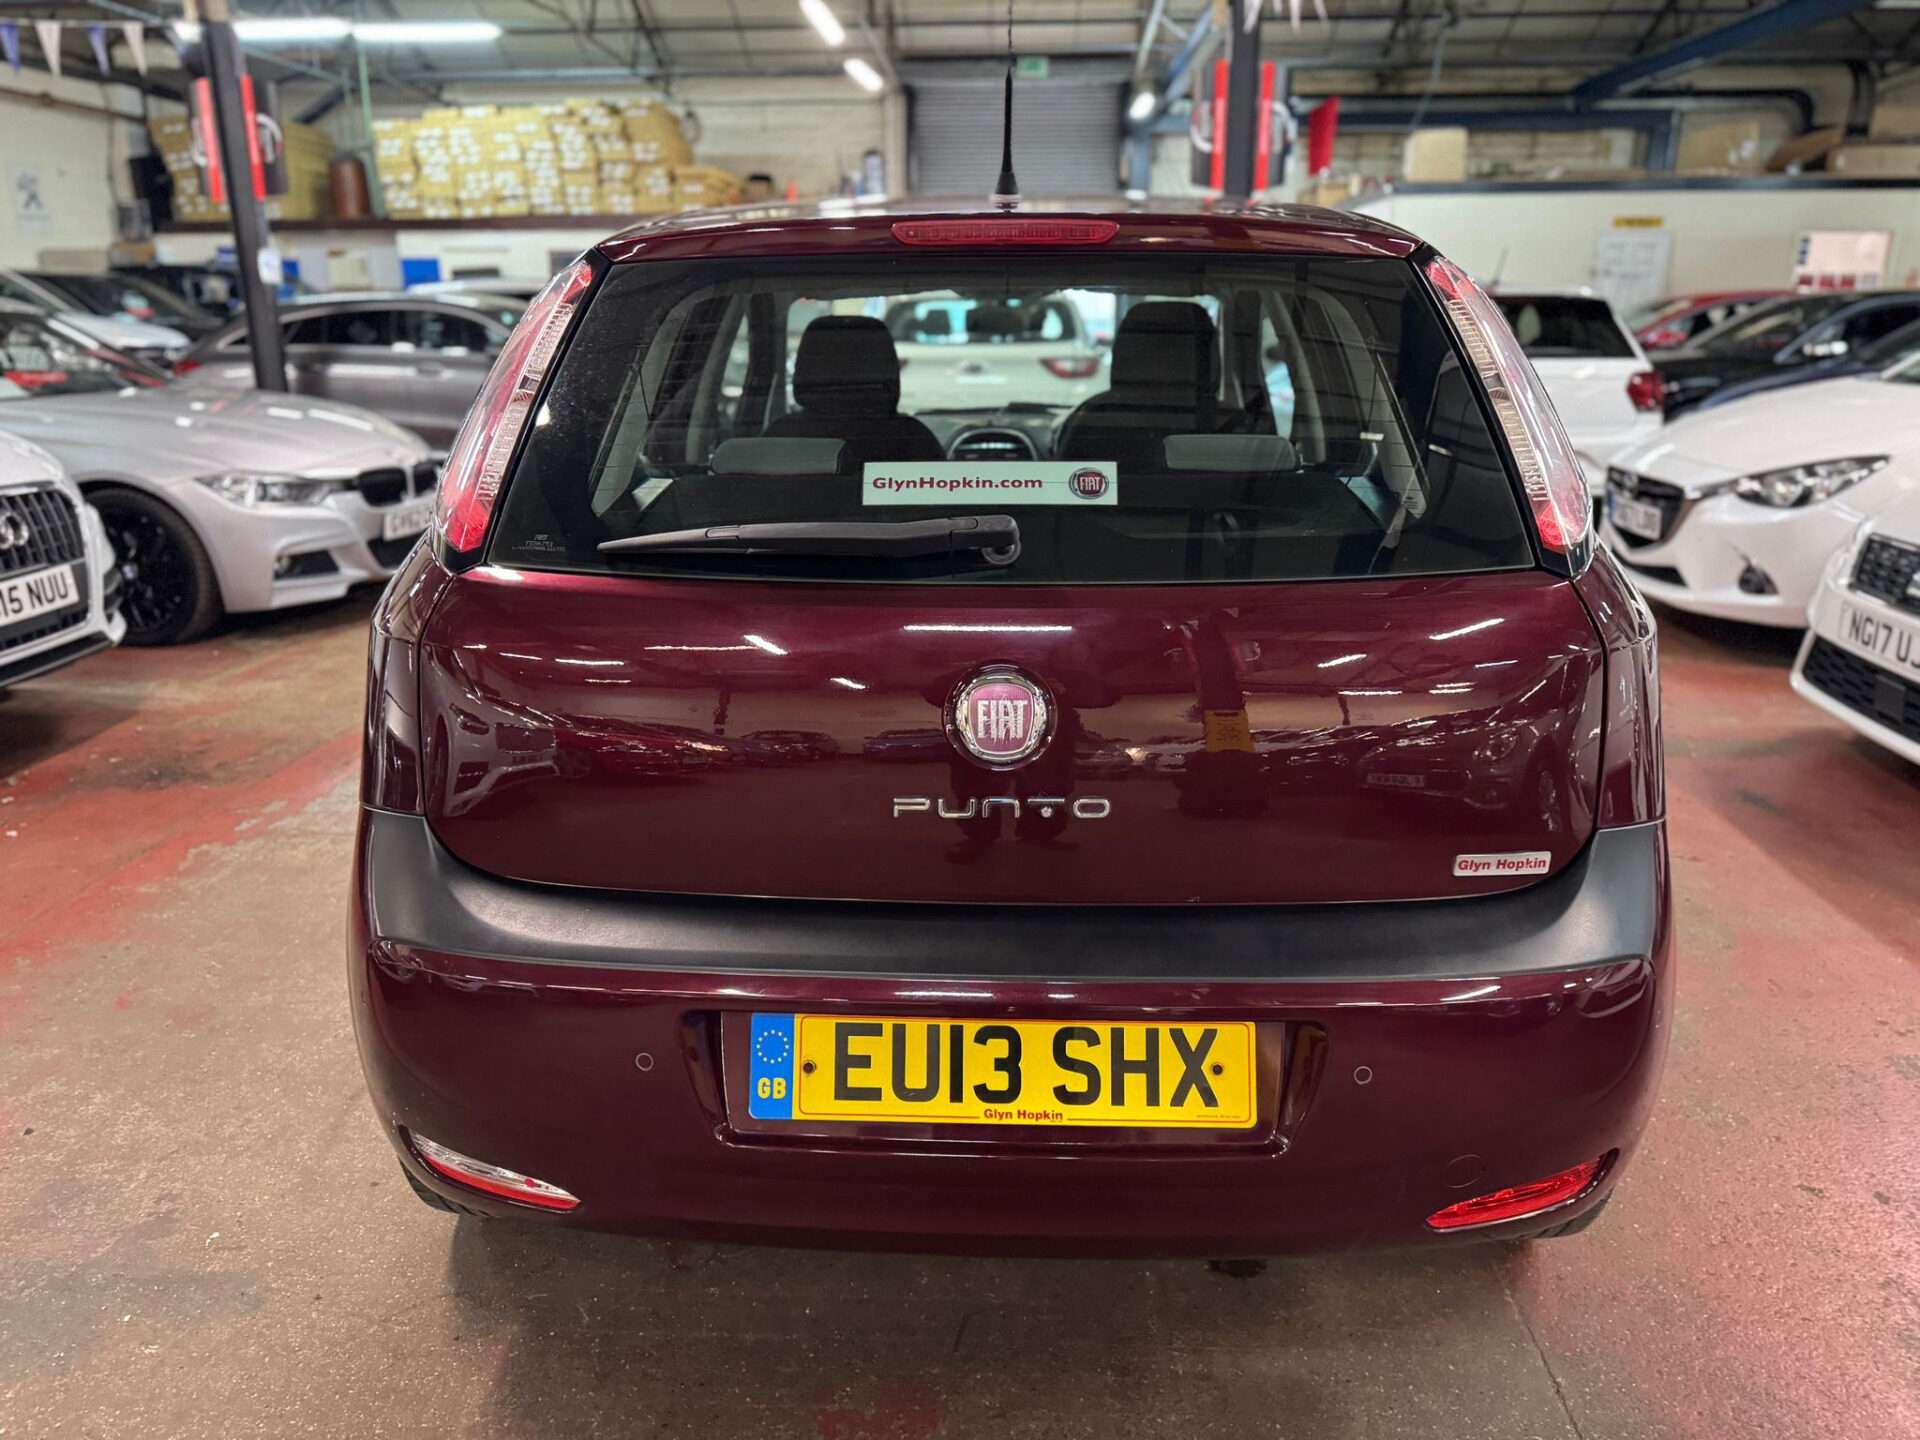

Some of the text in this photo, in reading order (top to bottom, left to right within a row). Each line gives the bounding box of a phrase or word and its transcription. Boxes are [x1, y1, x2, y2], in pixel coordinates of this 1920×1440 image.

[872, 476, 1043, 491] GlynHopkin.com
[1079, 478, 1101, 491] FIAT
[26, 571, 68, 609] NUU
[1896, 629, 1920, 668] U
[976, 699, 1029, 744] FIAT
[893, 797, 1111, 819] PUNTO
[1458, 857, 1546, 873] Glyn Hopkin
[833, 1021, 1219, 1108] EU13 SHX
[757, 1077, 787, 1100] GB
[983, 1108, 1063, 1122] Glyn Hopkin
